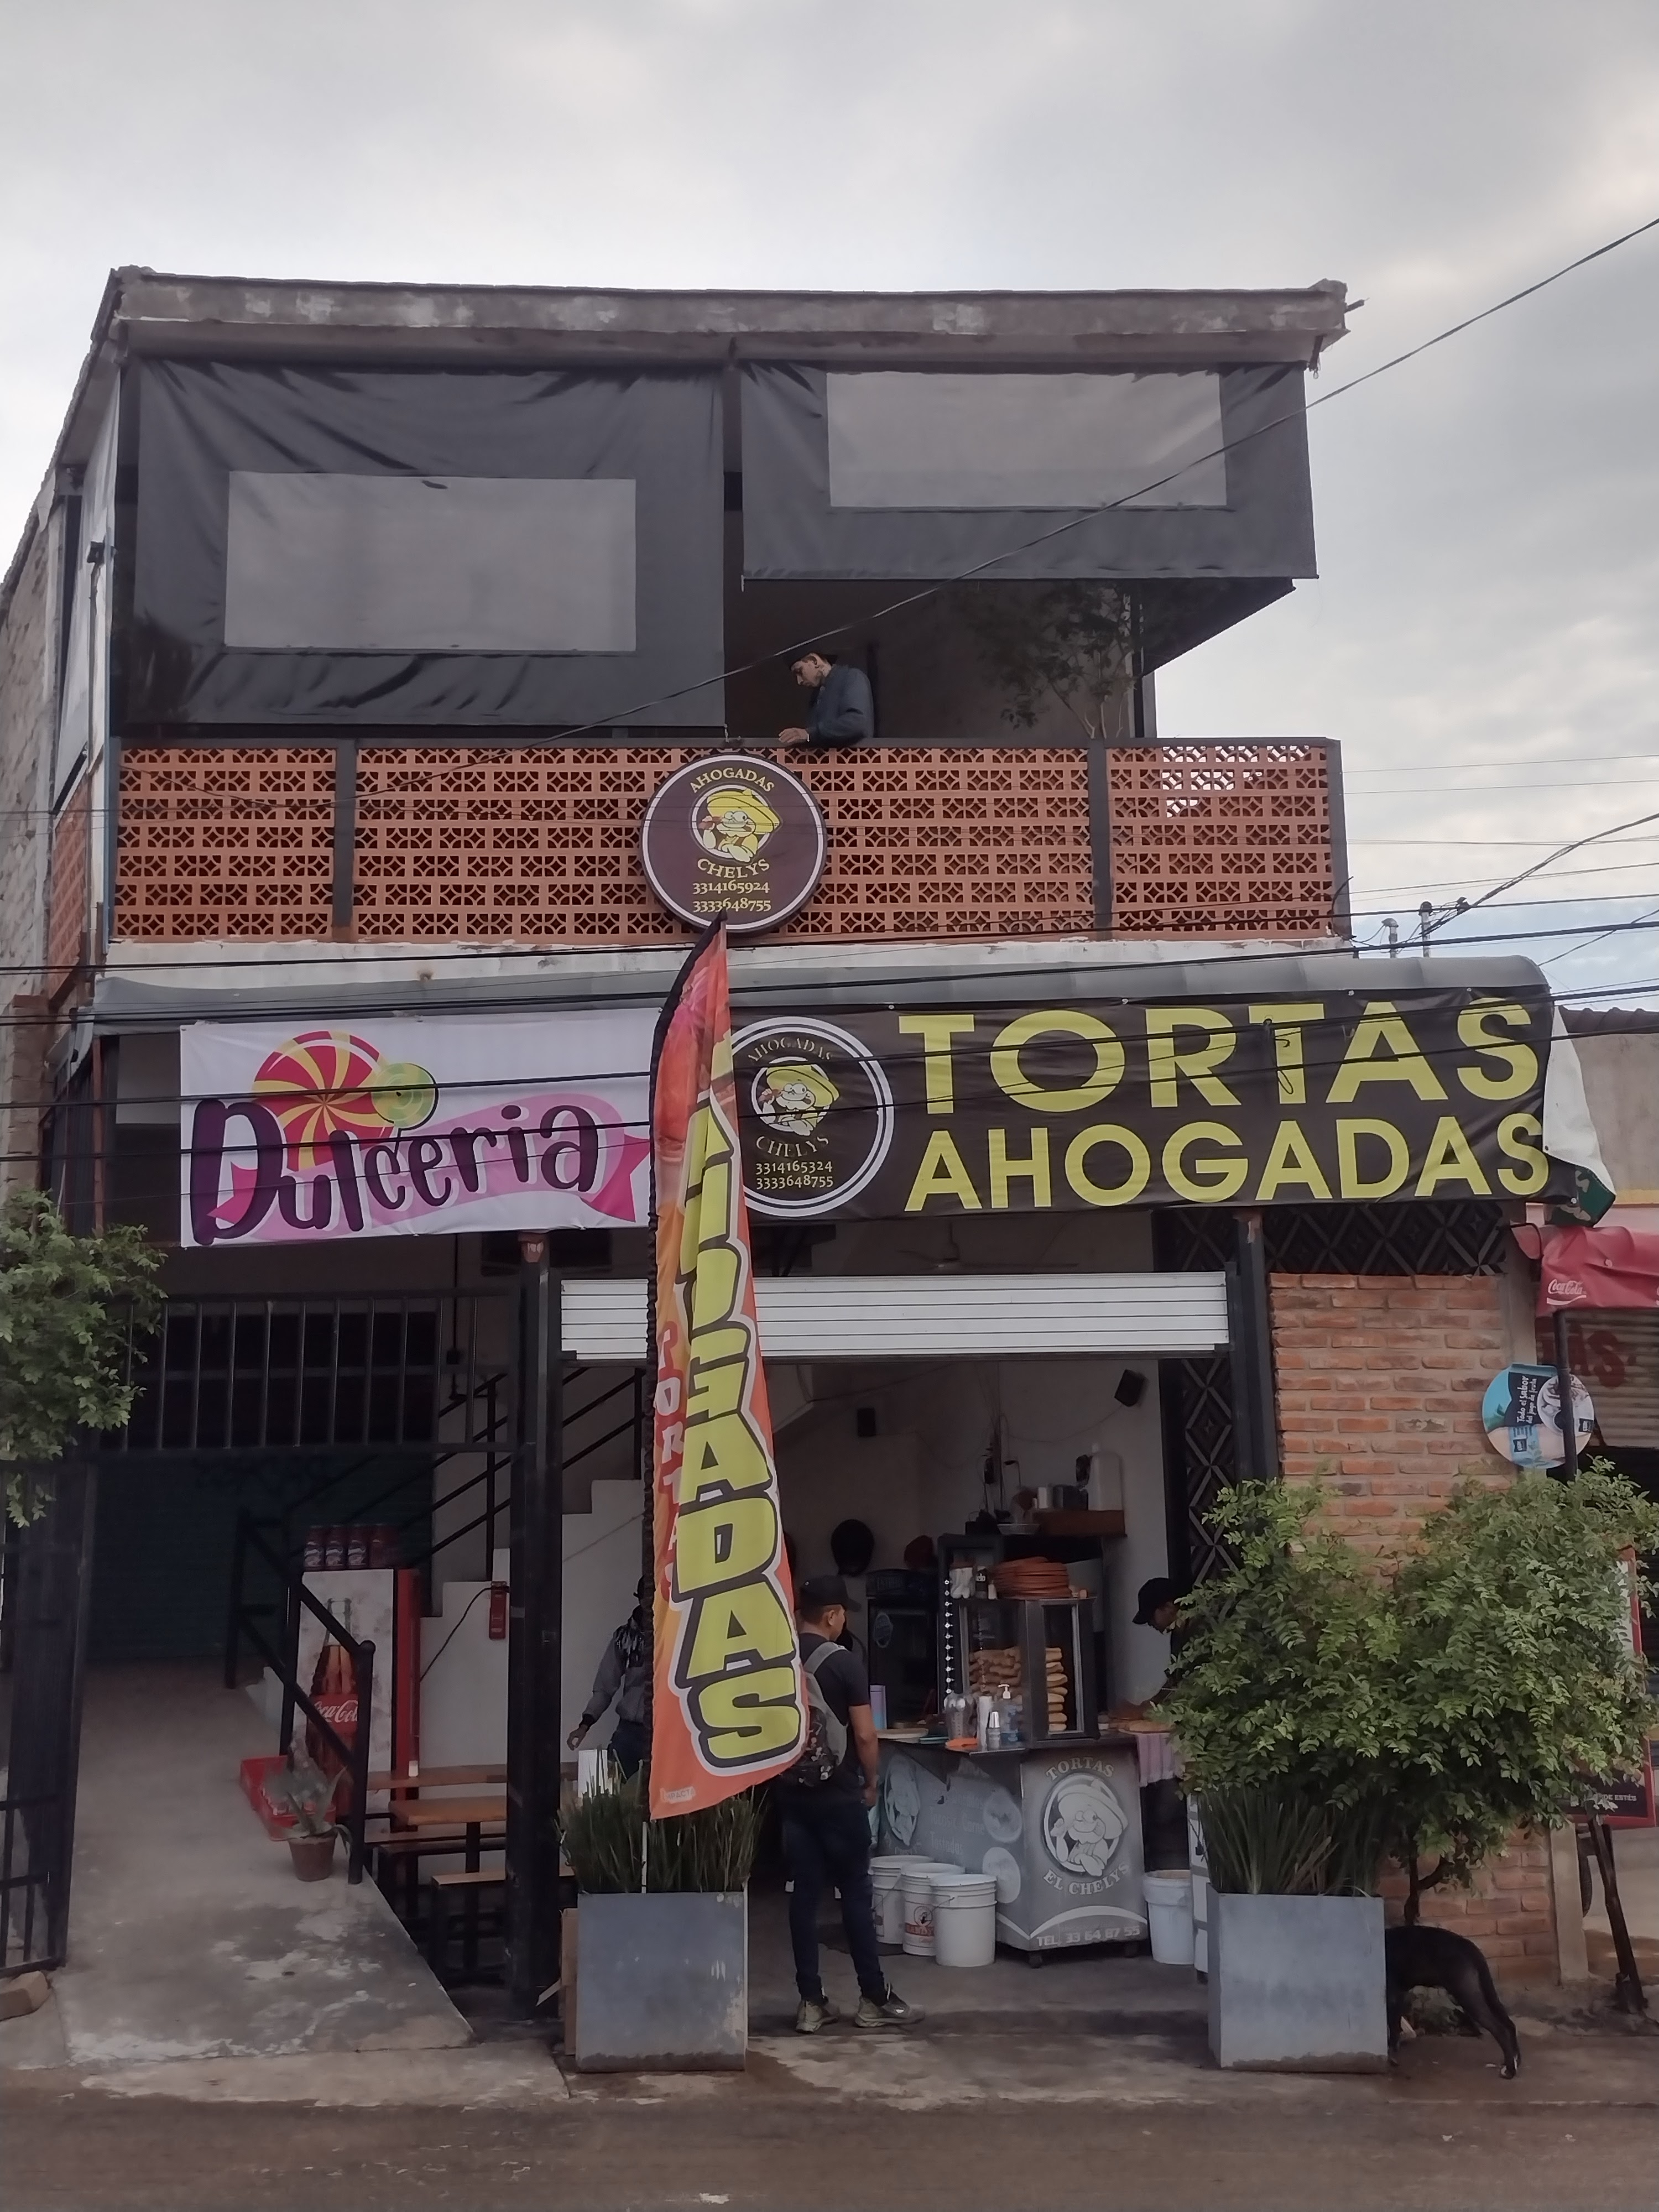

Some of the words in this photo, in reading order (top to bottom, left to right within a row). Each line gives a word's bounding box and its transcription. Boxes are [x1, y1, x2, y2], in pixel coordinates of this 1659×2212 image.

[690, 768, 775, 794] AHOGADAS
[697, 858, 770, 879] CHELYS
[692, 880, 770, 895] 3314165924
[692, 897, 771, 913] 3333648755
[748, 1037, 833, 1063] AHOGADAS
[899, 997, 1539, 1114] TORTAS
[755, 1135, 829, 1157] CHELYS
[190, 1098, 599, 1245] Dulceria
[755, 1160, 833, 1175] 3314165324
[904, 1112, 1549, 1212] AHOGADAS
[756, 1175, 834, 1190] 3333648755
[1517, 1408, 1526, 1423] Todo
[1046, 1757, 1115, 1781] TORTAS
[1043, 1870, 1063, 1891] EL
[1069, 1863, 1130, 1895] CHELYS
